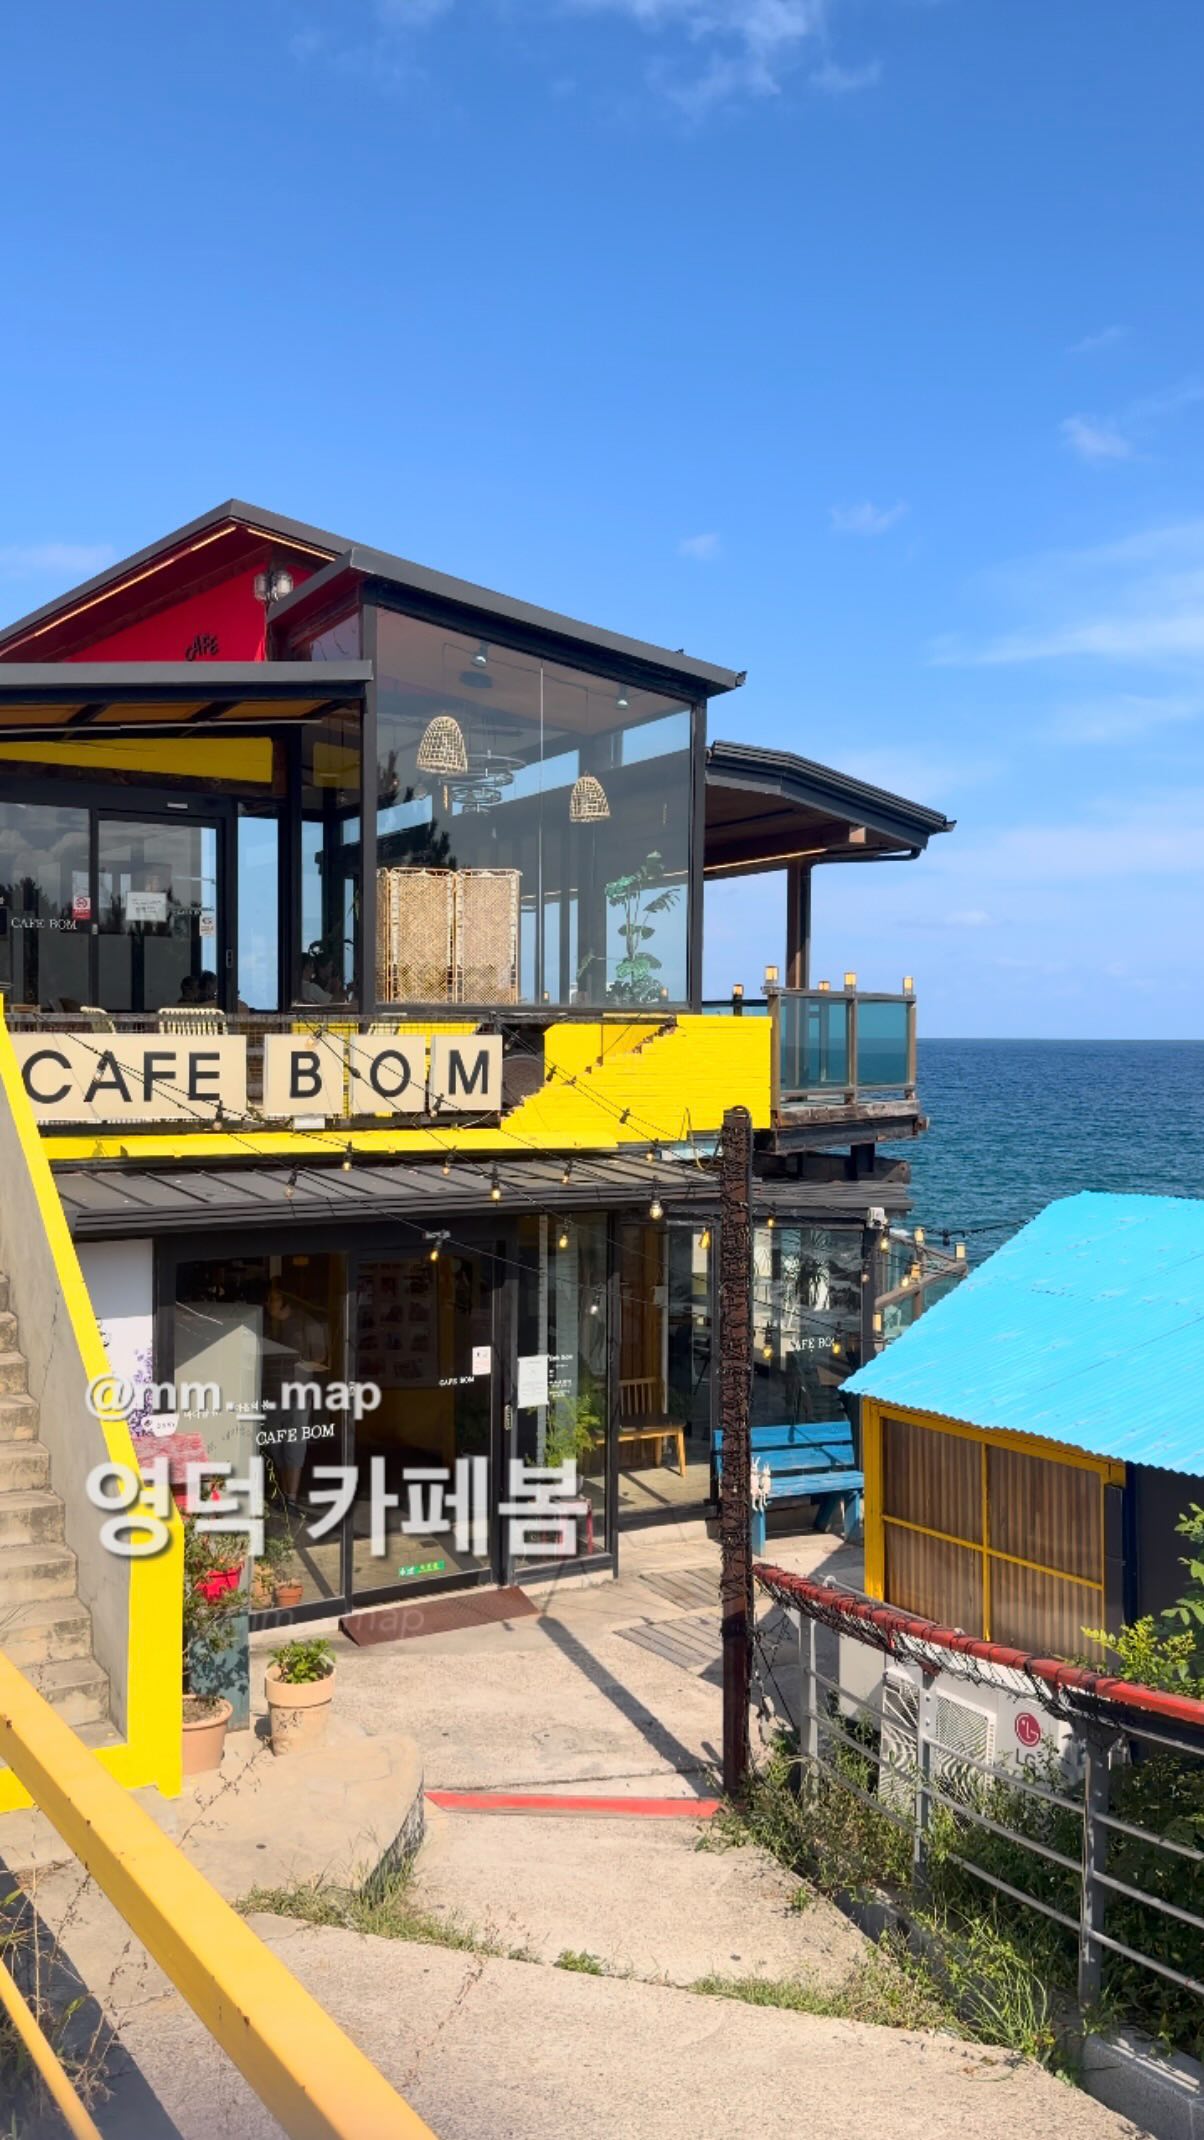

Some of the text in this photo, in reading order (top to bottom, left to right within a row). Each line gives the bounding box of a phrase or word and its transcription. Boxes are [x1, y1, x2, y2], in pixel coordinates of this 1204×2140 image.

[50, 918, 78, 930] BOM
[22, 1049, 489, 1104] CAFE BOM
[256, 1428, 298, 1446] CAFE
[302, 1423, 335, 1439] BOM
[1015, 1747, 1037, 1769] LG
